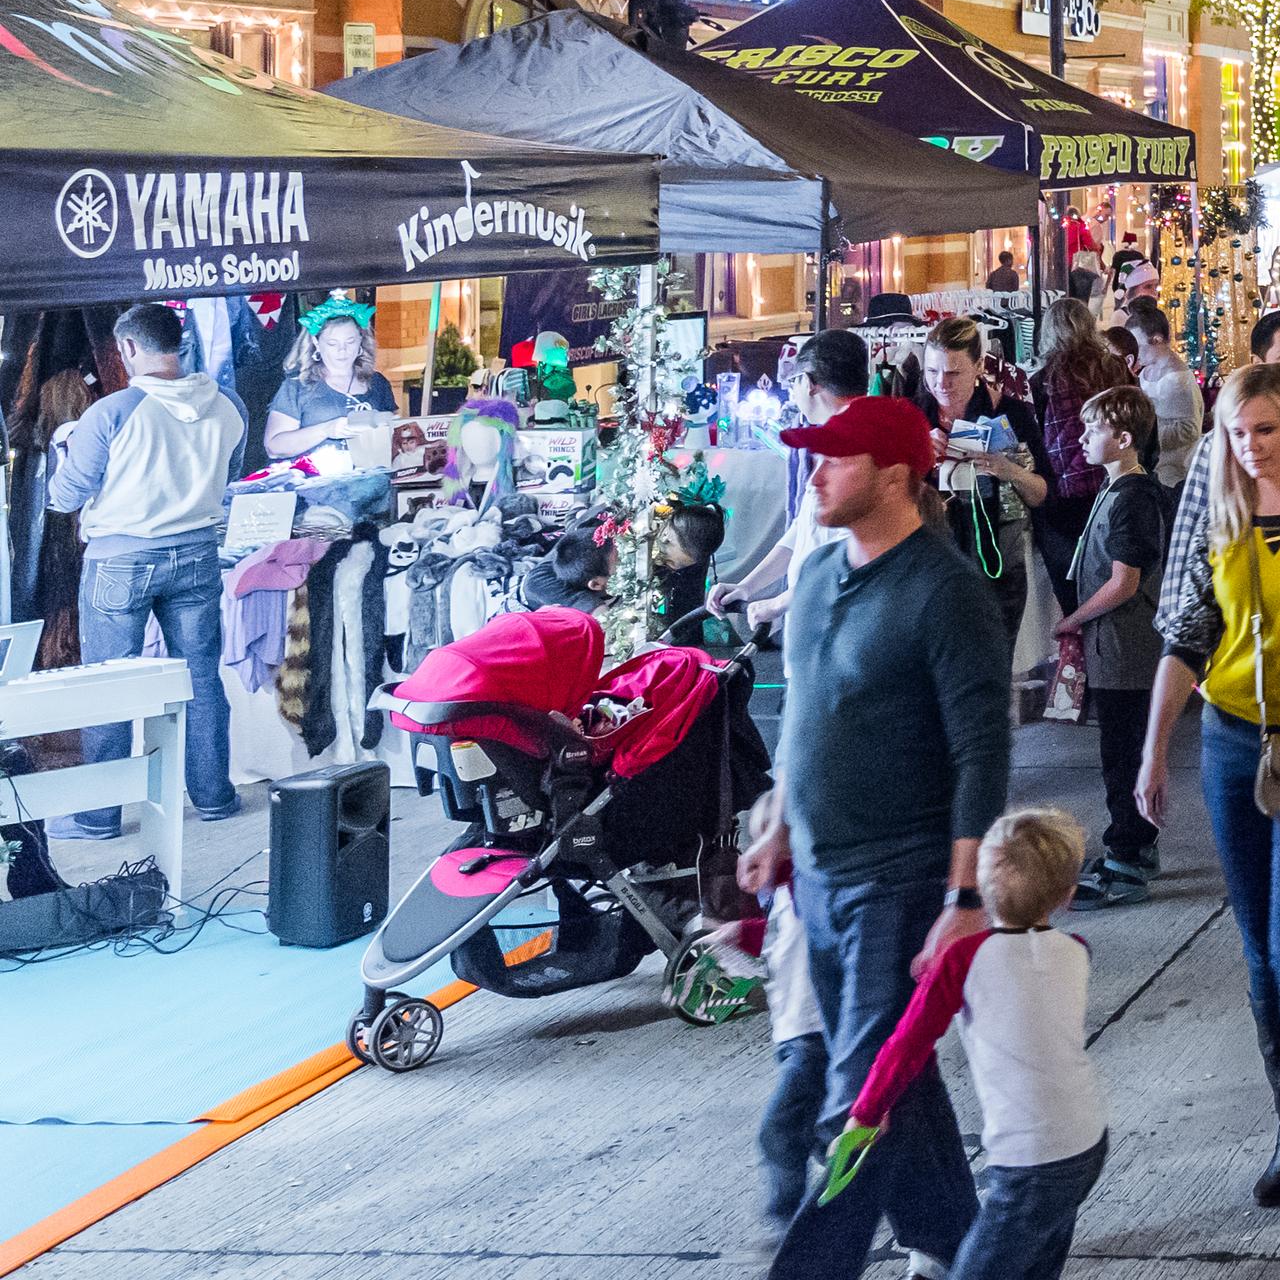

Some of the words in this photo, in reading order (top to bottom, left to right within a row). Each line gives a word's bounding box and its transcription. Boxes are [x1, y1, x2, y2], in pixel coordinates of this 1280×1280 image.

[771, 70, 888, 86] FURY
[1040, 133, 1132, 180] FRISCO
[1133, 136, 1190, 176] FURY
[124, 171, 309, 250] YAMAHA
[144, 257, 218, 290] Music
[222, 250, 299, 285] School
[573, 304, 597, 321] GIRLS
[549, 437, 577, 446] WILD
[540, 501, 568, 509] WILD
[620, 887, 646, 915] B-AGILE
